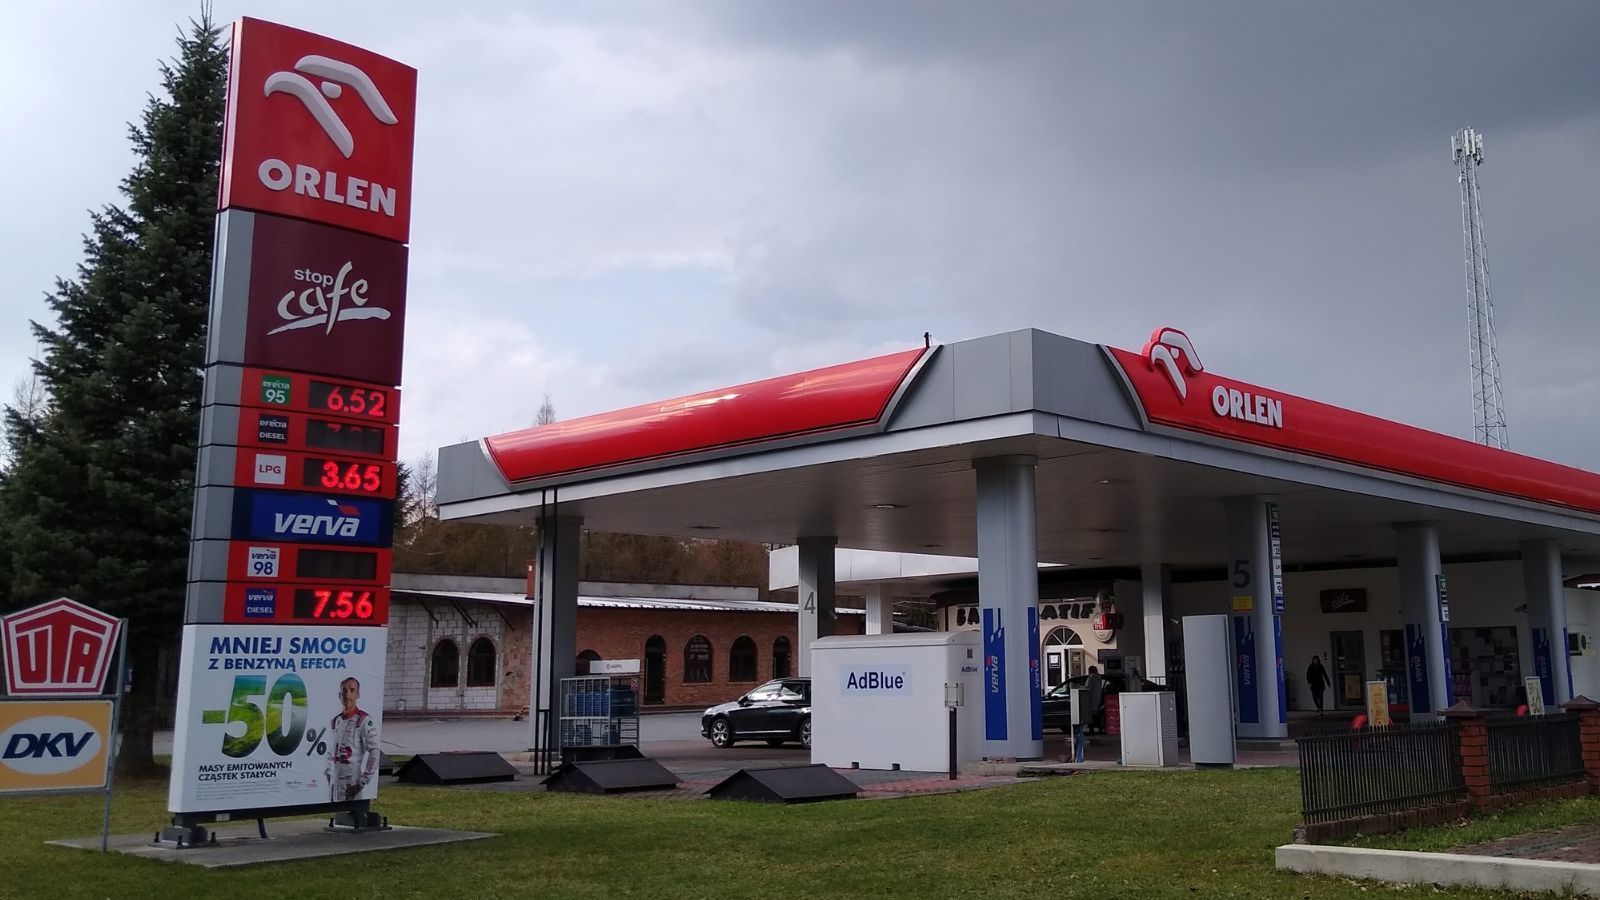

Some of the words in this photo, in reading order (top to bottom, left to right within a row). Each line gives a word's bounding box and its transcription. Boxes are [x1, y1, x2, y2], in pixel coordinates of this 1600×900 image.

[258, 158, 396, 217] ORLEN
[294, 268, 333, 287] stop
[276, 261, 370, 335] cafe
[265, 389, 286, 404] 95
[327, 386, 386, 417] 6.52
[1212, 385, 1283, 428] ORLEN
[259, 431, 286, 440] DIESEL
[258, 464, 281, 475] LPG
[321, 461, 381, 492] 3.65
[274, 512, 361, 537] verva
[251, 552, 277, 561] verva
[253, 562, 274, 576] 98
[1233, 559, 1251, 588] 5
[248, 593, 274, 602] verva
[313, 591, 373, 618] 7.56
[803, 591, 816, 615] 4
[1040, 603, 1096, 620] ATIF
[15, 610, 107, 683] UTA
[210, 636, 282, 654] MNIEJ
[289, 636, 367, 655] SMOGU
[208, 658, 219, 670] Z
[224, 657, 296, 672] BENZYNĄ
[301, 657, 346, 670] EFECTA
[961, 665, 978, 673] AdBlue
[991, 655, 999, 693] verva
[1243, 654, 1251, 686] verva
[847, 671, 904, 690] AdBlue
[2, 731, 95, 759] DKV
[198, 764, 225, 773] MASY
[226, 761, 293, 771] EMITOWANYCH
[198, 771, 238, 782] CZĄSTEK
[240, 770, 277, 780] STAŁYCH
